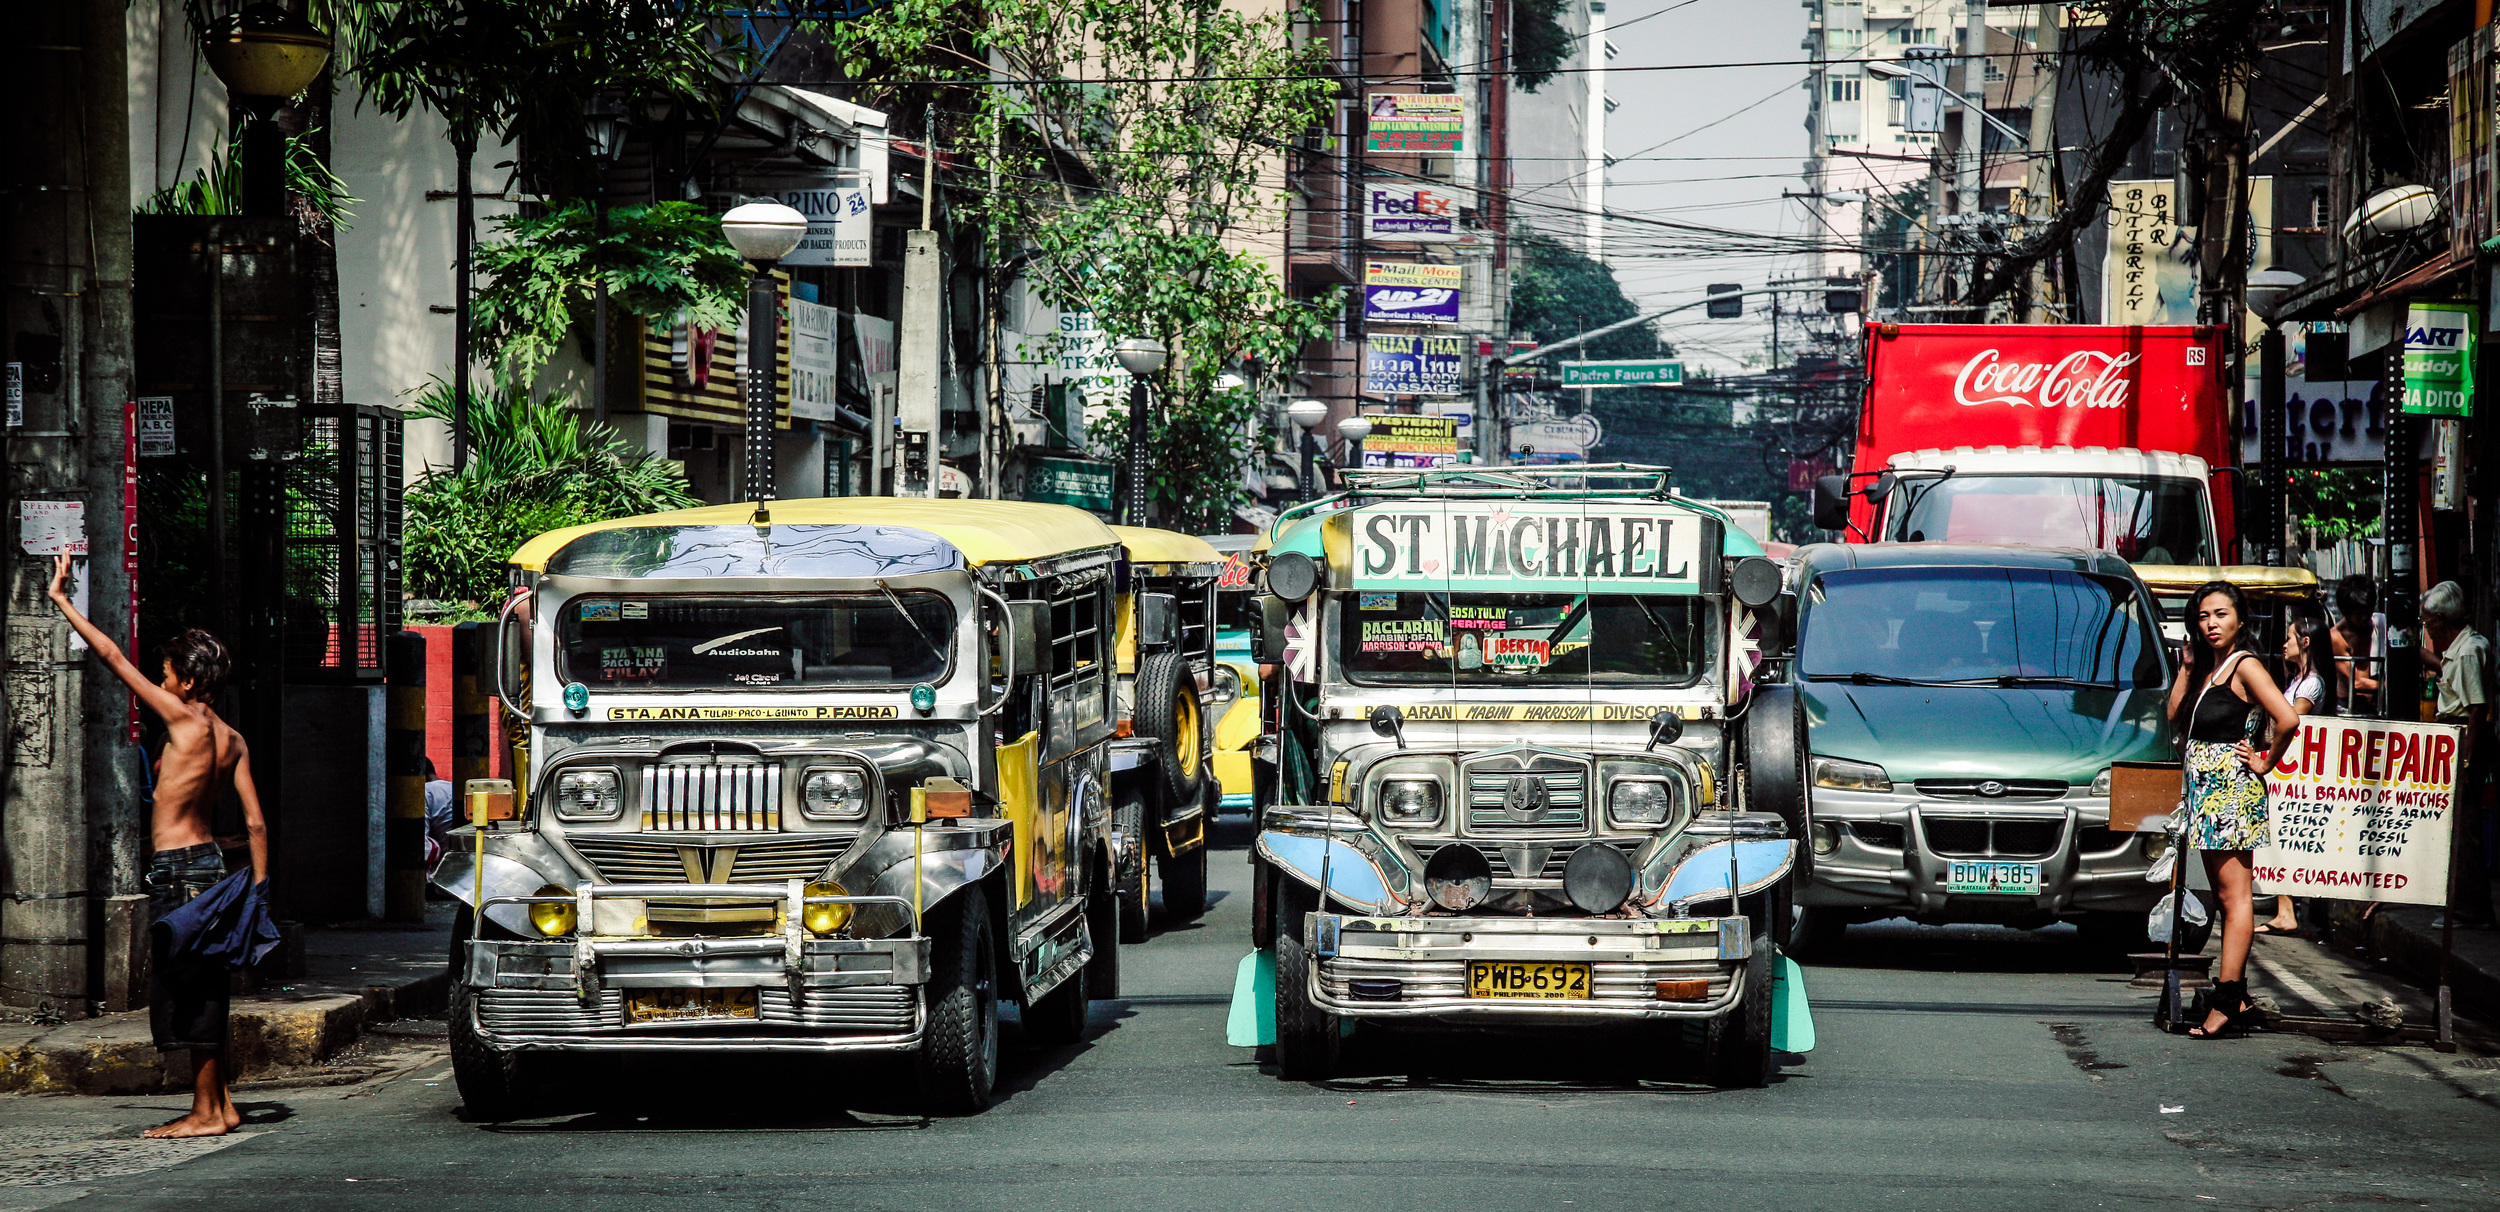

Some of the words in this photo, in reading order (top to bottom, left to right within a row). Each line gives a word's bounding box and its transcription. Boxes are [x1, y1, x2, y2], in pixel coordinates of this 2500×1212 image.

[845, 191, 861, 202] OPEN
[1373, 191, 1451, 214] FedEx
[848, 196, 865, 212] 24
[2150, 194, 2169, 247] BAR
[810, 240, 833, 250] BAKERY
[834, 240, 867, 250] PRODUCTS
[2126, 188, 2145, 311] BUTTERFLY
[1383, 265, 1416, 275] Mail
[1422, 266, 1460, 277] More
[1370, 276, 1418, 285] BUSINESS
[1421, 277, 1459, 286] CENTER
[799, 304, 829, 333] MARINO
[1367, 311, 1411, 319] Authorized
[2405, 327, 2464, 346] ART
[1369, 336, 1417, 354] NUAT
[1420, 338, 1462, 355] THAI
[2188, 349, 2204, 363] RS
[1570, 370, 1610, 381] Padre
[1614, 369, 1655, 380] Faura
[1658, 368, 1674, 379] St
[2405, 360, 2460, 376] uddy
[1369, 371, 1406, 382] FOOT
[1408, 372, 1419, 382] &
[1421, 373, 1459, 384] BODY
[1954, 349, 2143, 409] Coca-Cola
[1369, 381, 1460, 393] MASSAGE
[2425, 390, 2465, 408] DITO
[140, 400, 172, 413] HEPA
[165, 421, 172, 429] C
[1365, 416, 1444, 427] WESTERN
[1391, 427, 1444, 437] UNION
[23, 502, 60, 510] SPEAK
[1362, 621, 1444, 642] BACLARAN
[1450, 619, 1507, 630] HERITAGE
[636, 647, 665, 658] ANA
[708, 648, 780, 656] Audiobahn
[1484, 638, 1550, 665] LIBERTAD
[1495, 654, 1539, 665] OWWA
[604, 667, 660, 678] TULAY
[1365, 705, 1452, 719] BARAN
[1465, 705, 1514, 720] MABINI
[1523, 705, 1590, 720] HARRISON
[2339, 728, 2456, 787] REPAIR
[2285, 784, 2308, 799] ALL
[2316, 786, 2372, 803] BRAND
[2377, 789, 2392, 804] OF
[2395, 791, 2450, 810] WATCHES
[2278, 801, 2334, 814] CITIZEN
[2352, 805, 2393, 818] SWISS
[2400, 808, 2443, 821] ARMY
[2281, 814, 2329, 827] SEIKO
[2367, 819, 2413, 830] GUESS
[2278, 826, 2325, 839] GUCCI
[2278, 839, 2326, 854] TIMEX
[2359, 845, 2402, 858] ELGIN
[1955, 865, 1989, 883] BDW
[1999, 866, 2034, 884] 385
[2293, 868, 2408, 889] GUARANTEED
